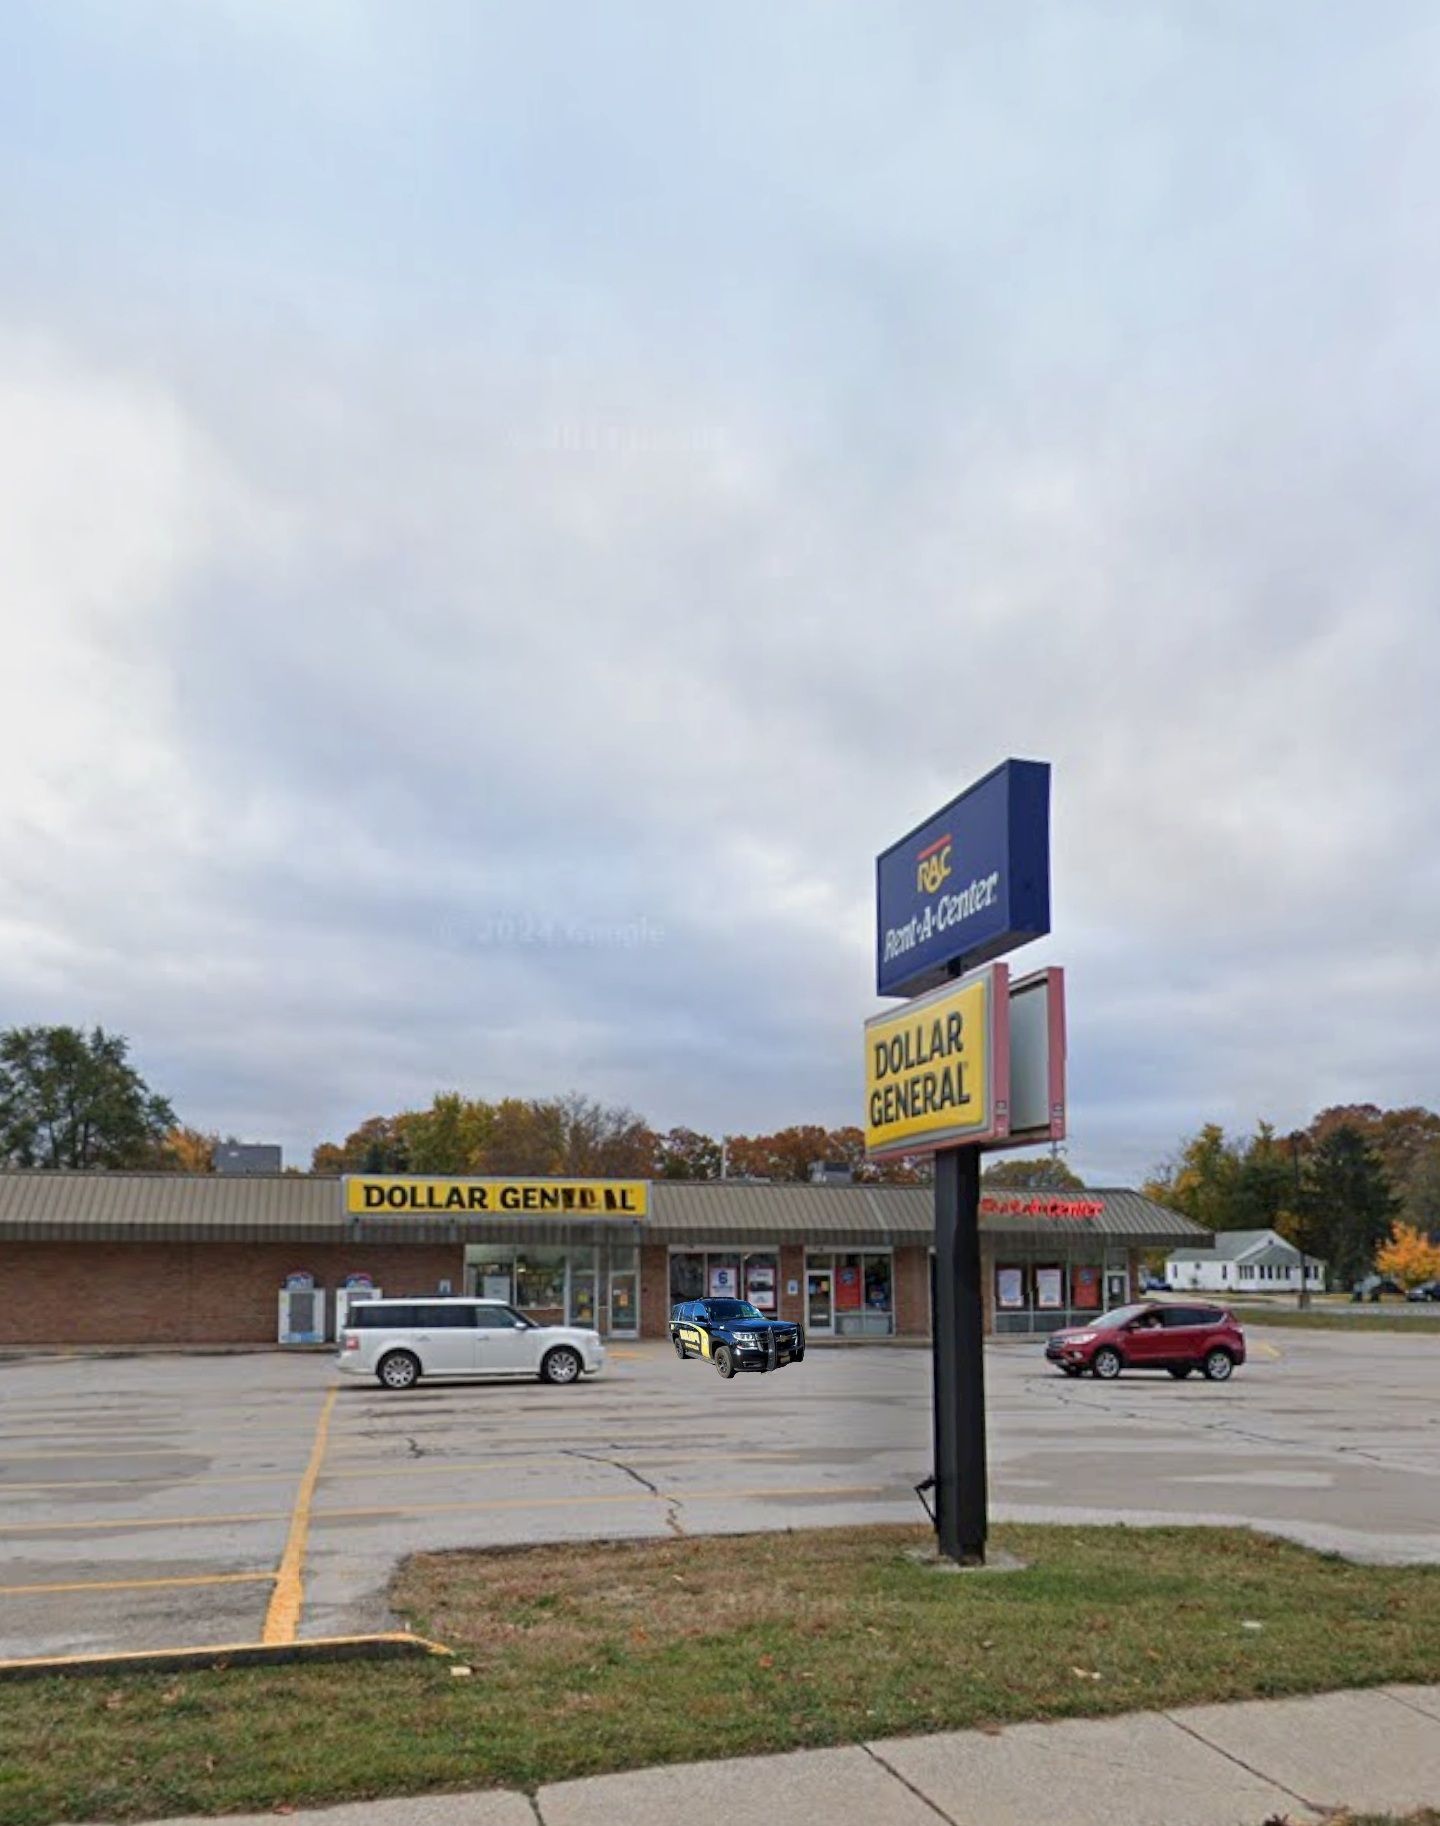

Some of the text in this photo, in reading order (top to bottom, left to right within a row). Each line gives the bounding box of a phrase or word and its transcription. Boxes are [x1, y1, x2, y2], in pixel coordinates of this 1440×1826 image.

[875, 1011, 963, 1080] DOLLAR
[870, 1061, 970, 1128] GENERAL
[363, 1185, 488, 1209] DOLLAR
